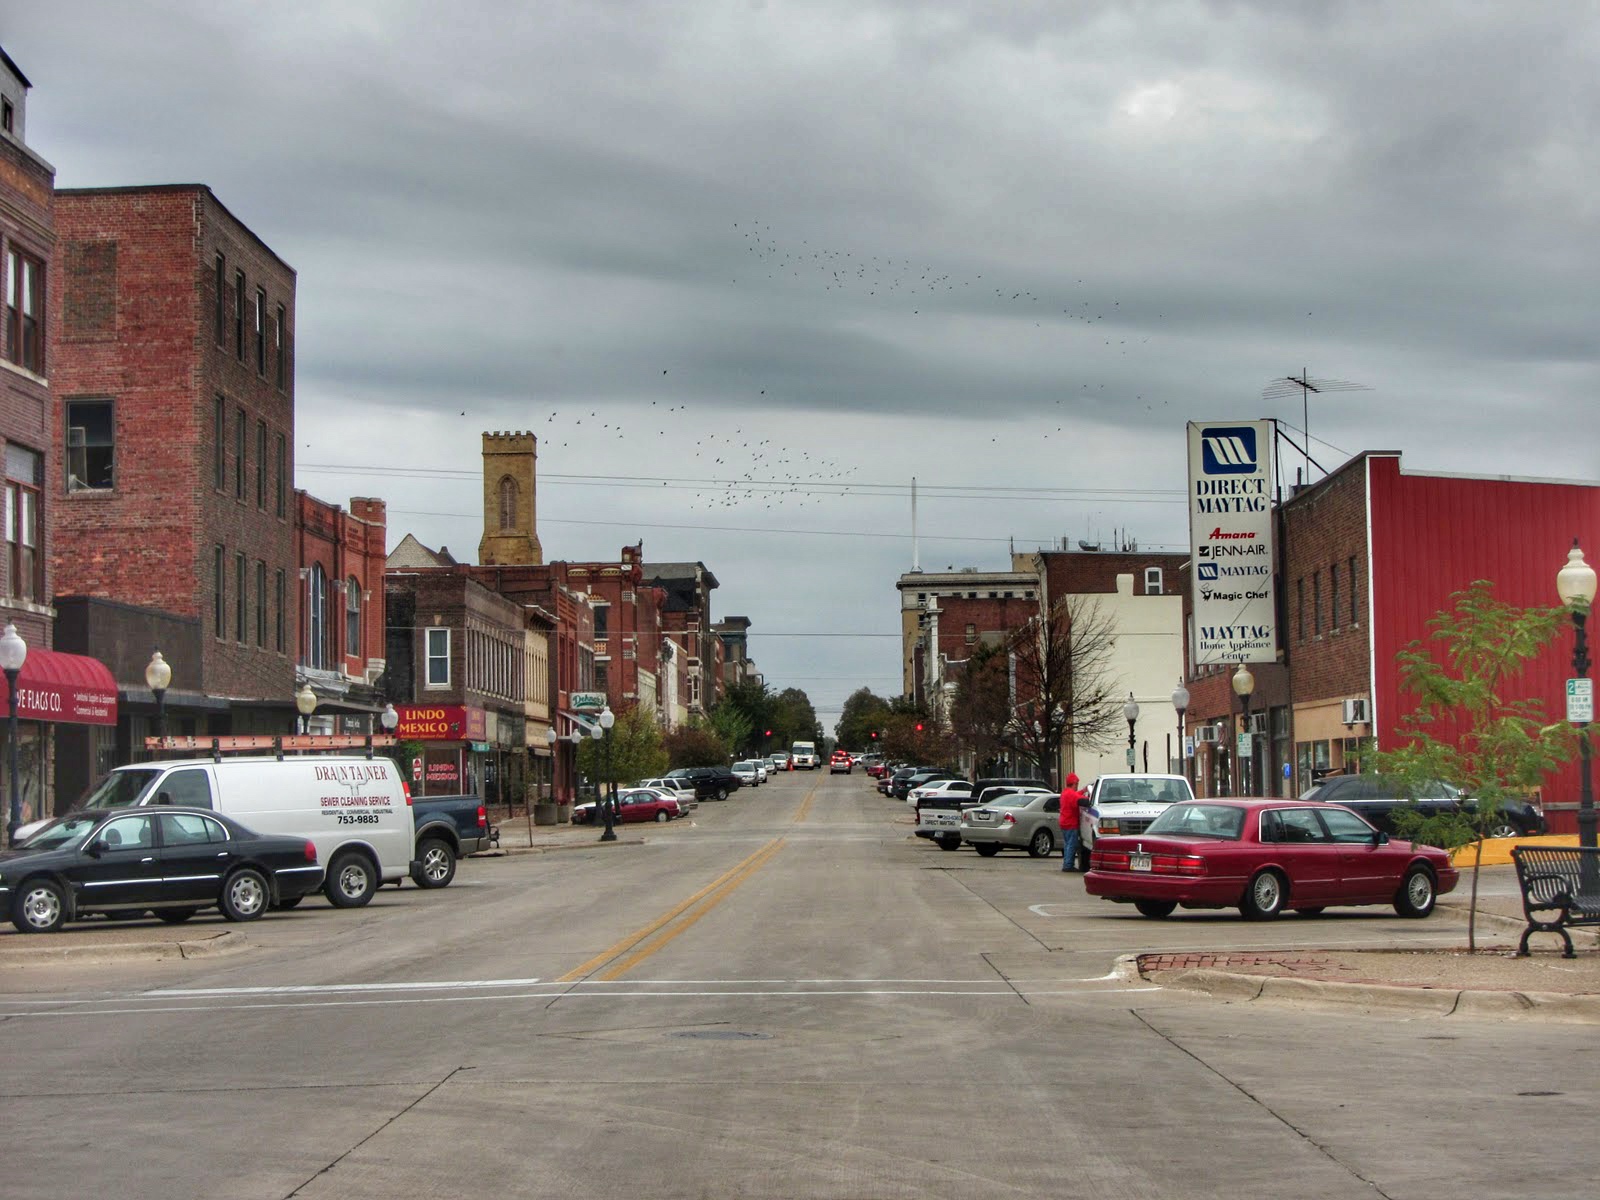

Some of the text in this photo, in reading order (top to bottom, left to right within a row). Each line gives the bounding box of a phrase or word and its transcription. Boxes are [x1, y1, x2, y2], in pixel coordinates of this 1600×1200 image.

[1196, 479, 1265, 495] DIRECT
[1196, 497, 1265, 513] MAYTAG
[1208, 527, 1256, 540] Amana
[1211, 544, 1267, 560] JENN-AIR
[1220, 565, 1268, 576] MAYTAG
[1213, 590, 1268, 601] Magic Chef
[1200, 625, 1270, 640] MAYTAG
[1200, 640, 1271, 651] Home Appliance
[1221, 651, 1251, 660] Center
[1568, 682, 1575, 694] 2
[27, 690, 49, 711] FLAGS
[50, 692, 62, 712] CO.
[405, 709, 445, 720] LINDO
[399, 722, 448, 733] MEXICO
[320, 796, 391, 807] SEWER CLEANING SERVICE
[337, 815, 379, 825] 753-9883
